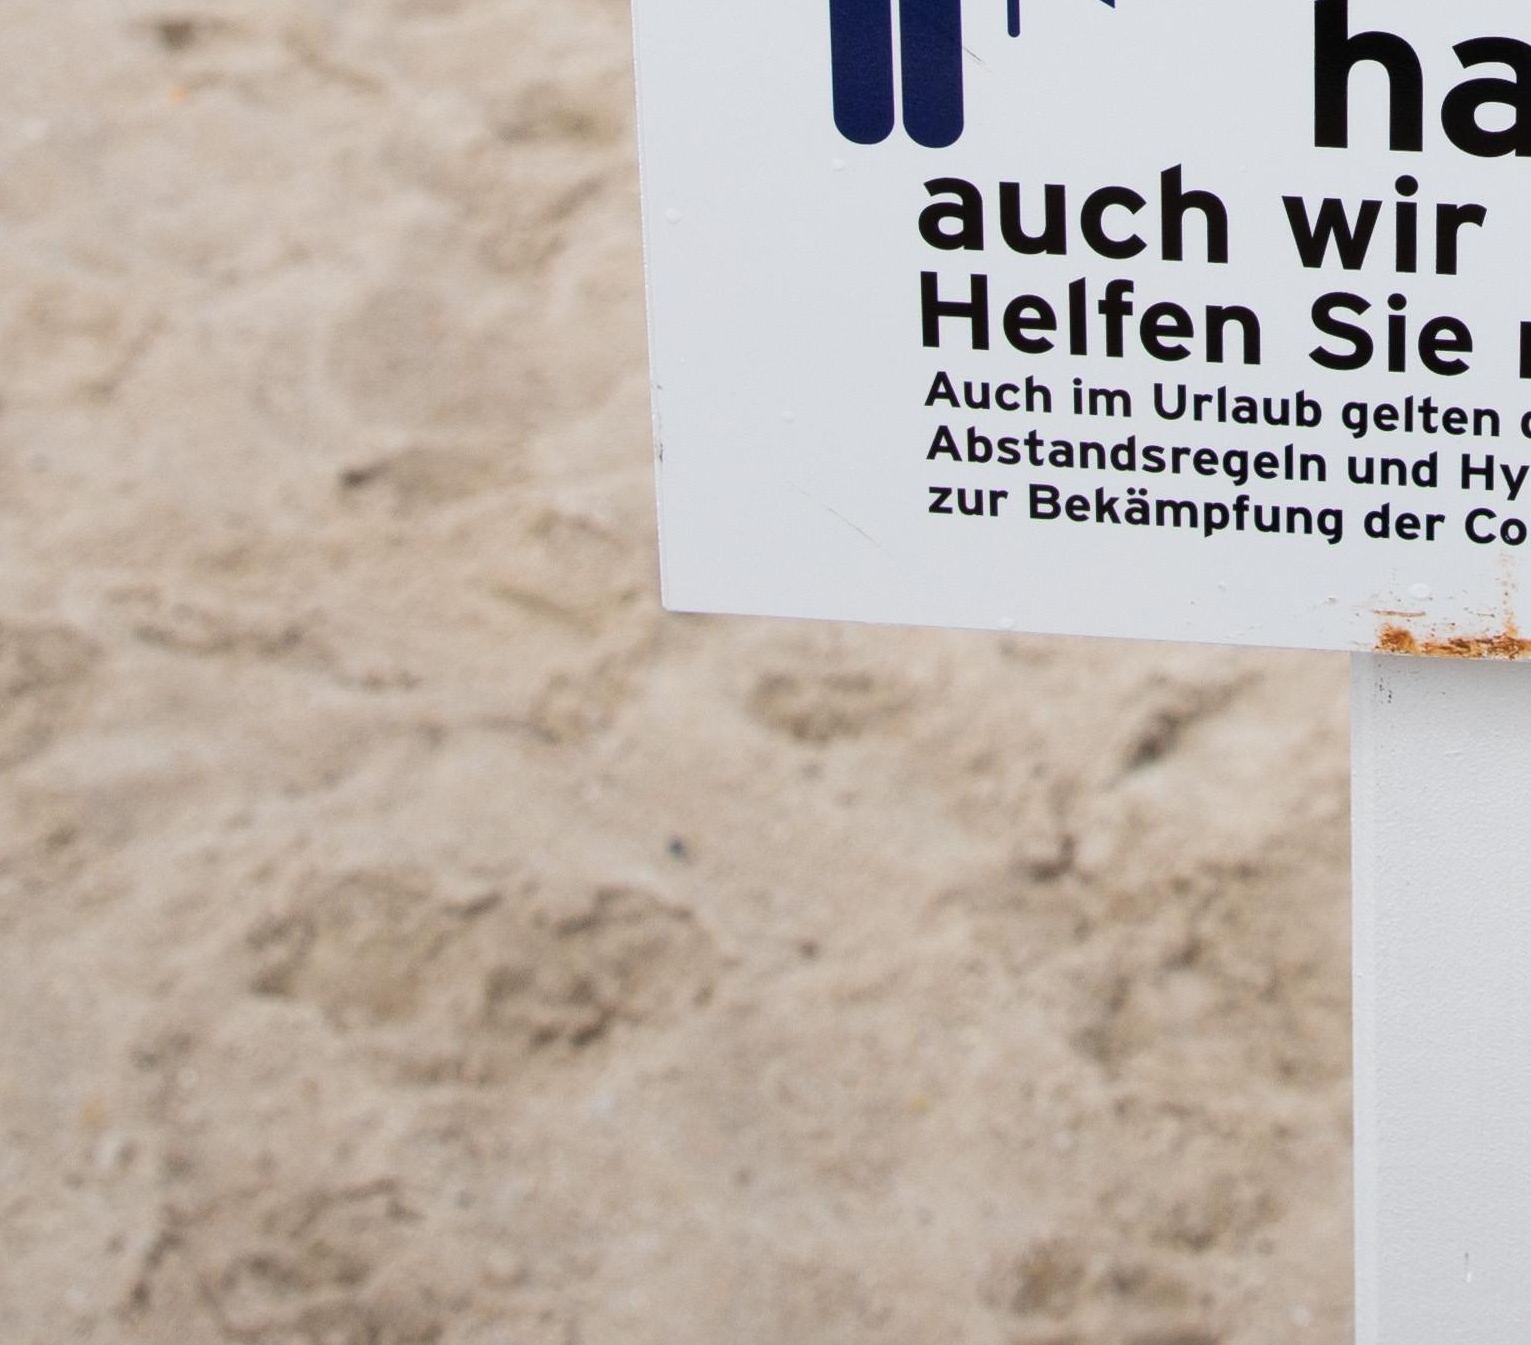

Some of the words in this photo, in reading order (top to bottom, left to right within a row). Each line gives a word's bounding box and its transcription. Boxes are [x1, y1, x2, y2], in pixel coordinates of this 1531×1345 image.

[918, 163, 1229, 264] auch
[1281, 174, 1488, 276] wir
[920, 270, 1261, 365] Helfen
[1308, 291, 1473, 377] Sie
[924, 371, 1052, 413] Auch
[1072, 377, 1132, 418] im
[1153, 382, 1322, 428] Urlaub
[1341, 395, 1500, 439] gelten
[926, 424, 1327, 486] Abstandsregeln
[1347, 451, 1438, 488] und
[928, 486, 1009, 517] zur
[1029, 483, 1343, 545] Bekämpfung
[1363, 502, 1446, 542] der
